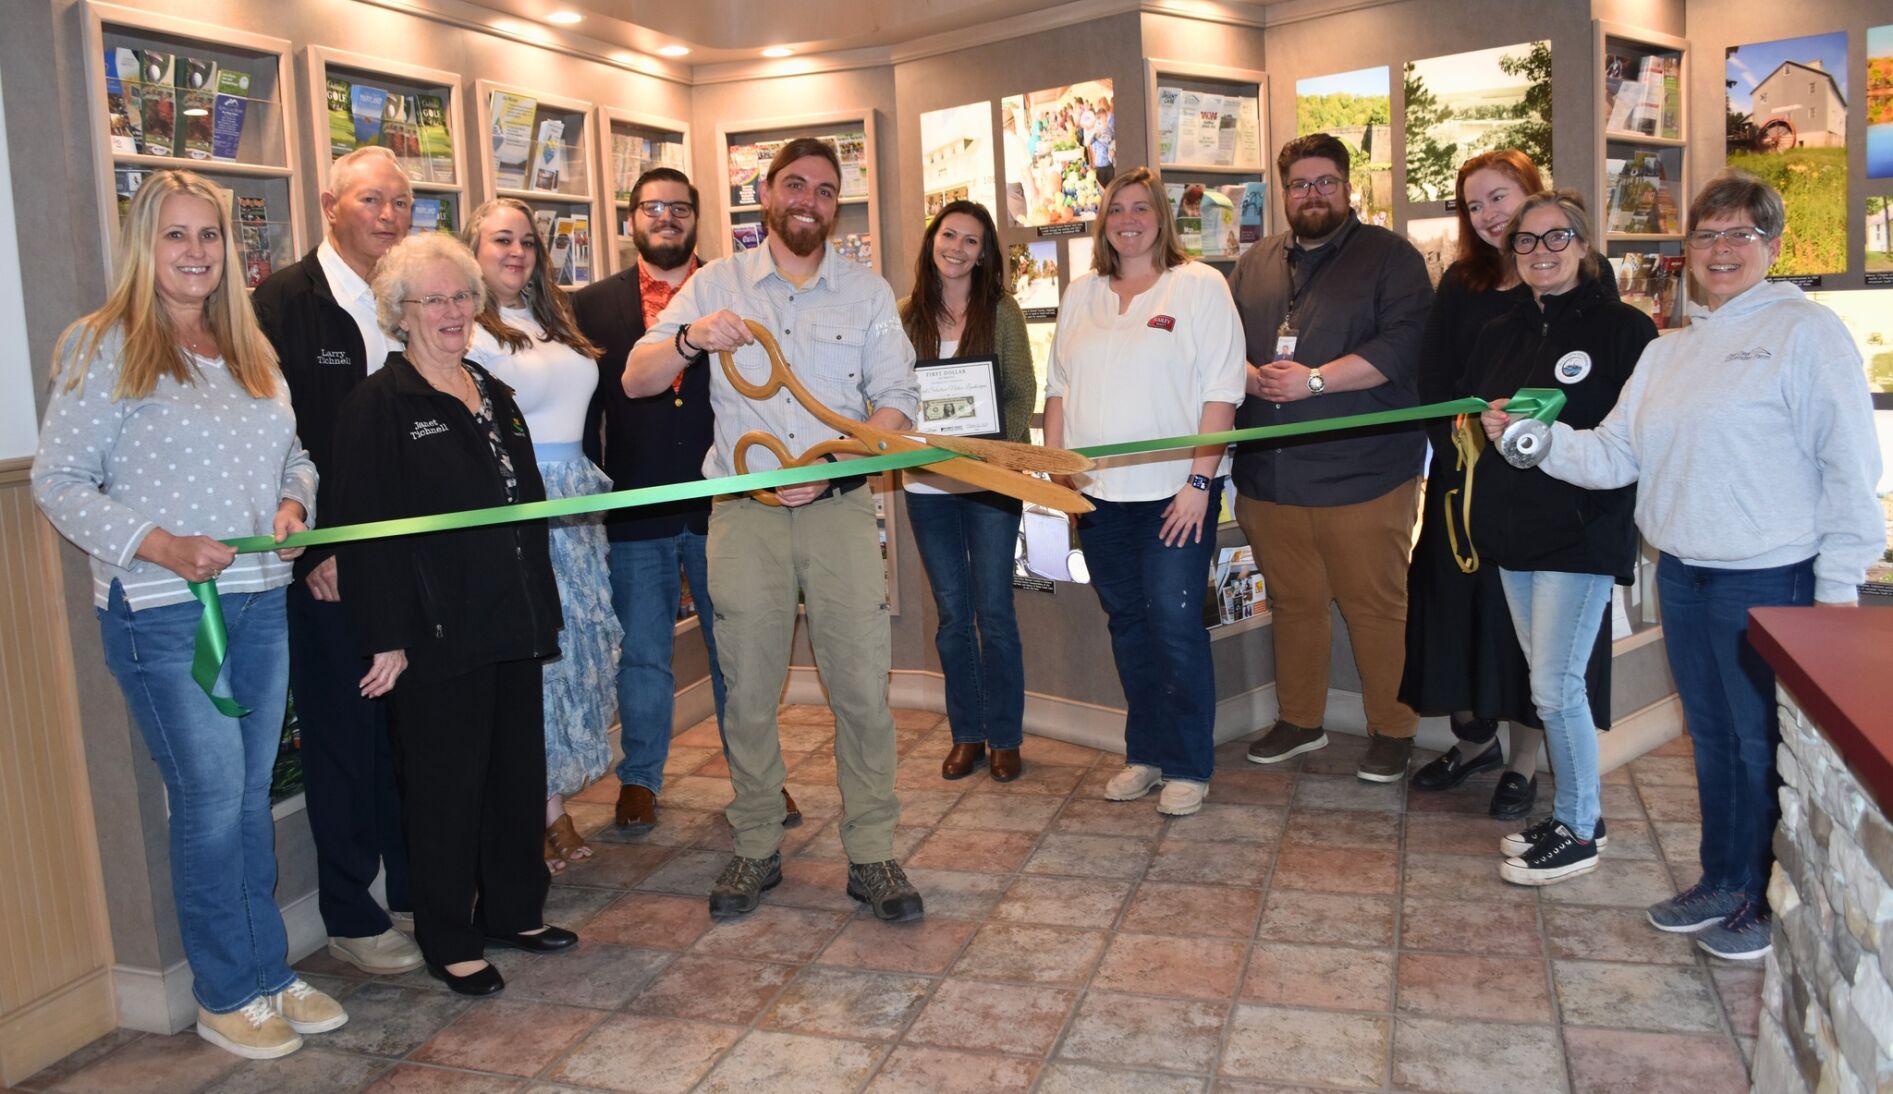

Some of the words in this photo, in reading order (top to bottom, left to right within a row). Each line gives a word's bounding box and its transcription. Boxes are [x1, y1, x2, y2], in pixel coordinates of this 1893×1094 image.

[317, 355, 352, 365] Tichnell
[321, 349, 346, 360] Larry
[414, 419, 439, 430] Janet
[410, 423, 449, 440] Tichnell
